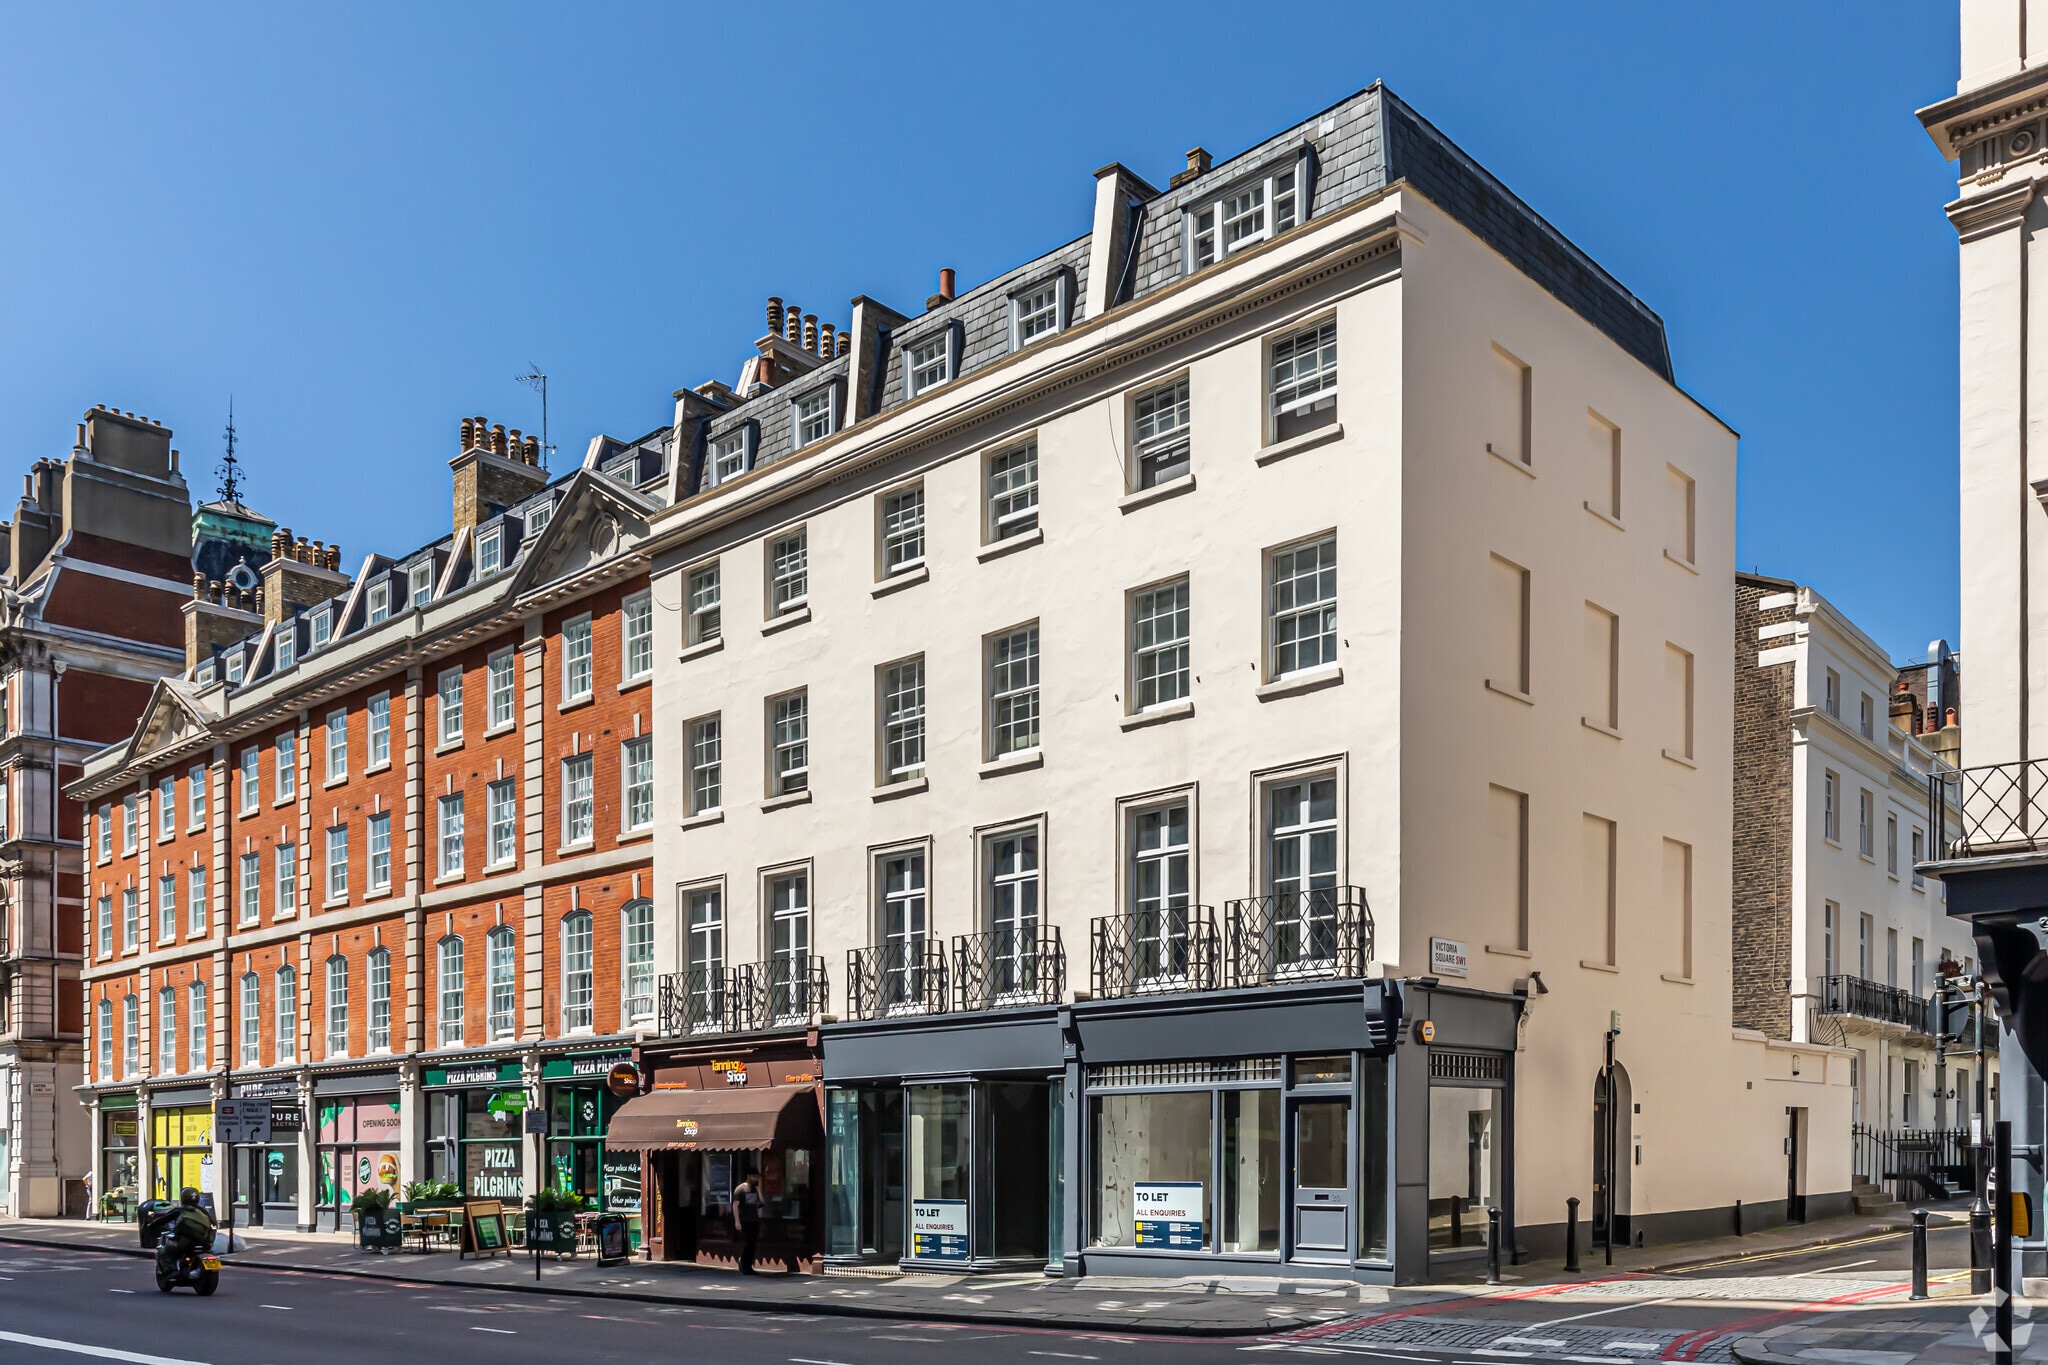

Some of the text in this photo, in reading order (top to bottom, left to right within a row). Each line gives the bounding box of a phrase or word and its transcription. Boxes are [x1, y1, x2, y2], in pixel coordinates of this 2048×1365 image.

[1435, 942, 1458, 953] VICTORIA
[1435, 953, 1466, 966] SQUARE SW1
[574, 1060, 596, 1074] PIZZA
[710, 1060, 738, 1073] Tanning
[446, 1070, 466, 1084] PIZZA
[727, 1071, 746, 1084] Shop
[240, 1084, 264, 1098] PURE
[362, 1118, 401, 1128] OPENING SOON
[676, 1120, 696, 1128] Tanning
[684, 1127, 698, 1137] Shop
[484, 1148, 516, 1168] PIZZA
[1136, 1193, 1168, 1201] TO LET
[926, 1209, 940, 1217] LET
[534, 1218, 548, 1228] ZZA
